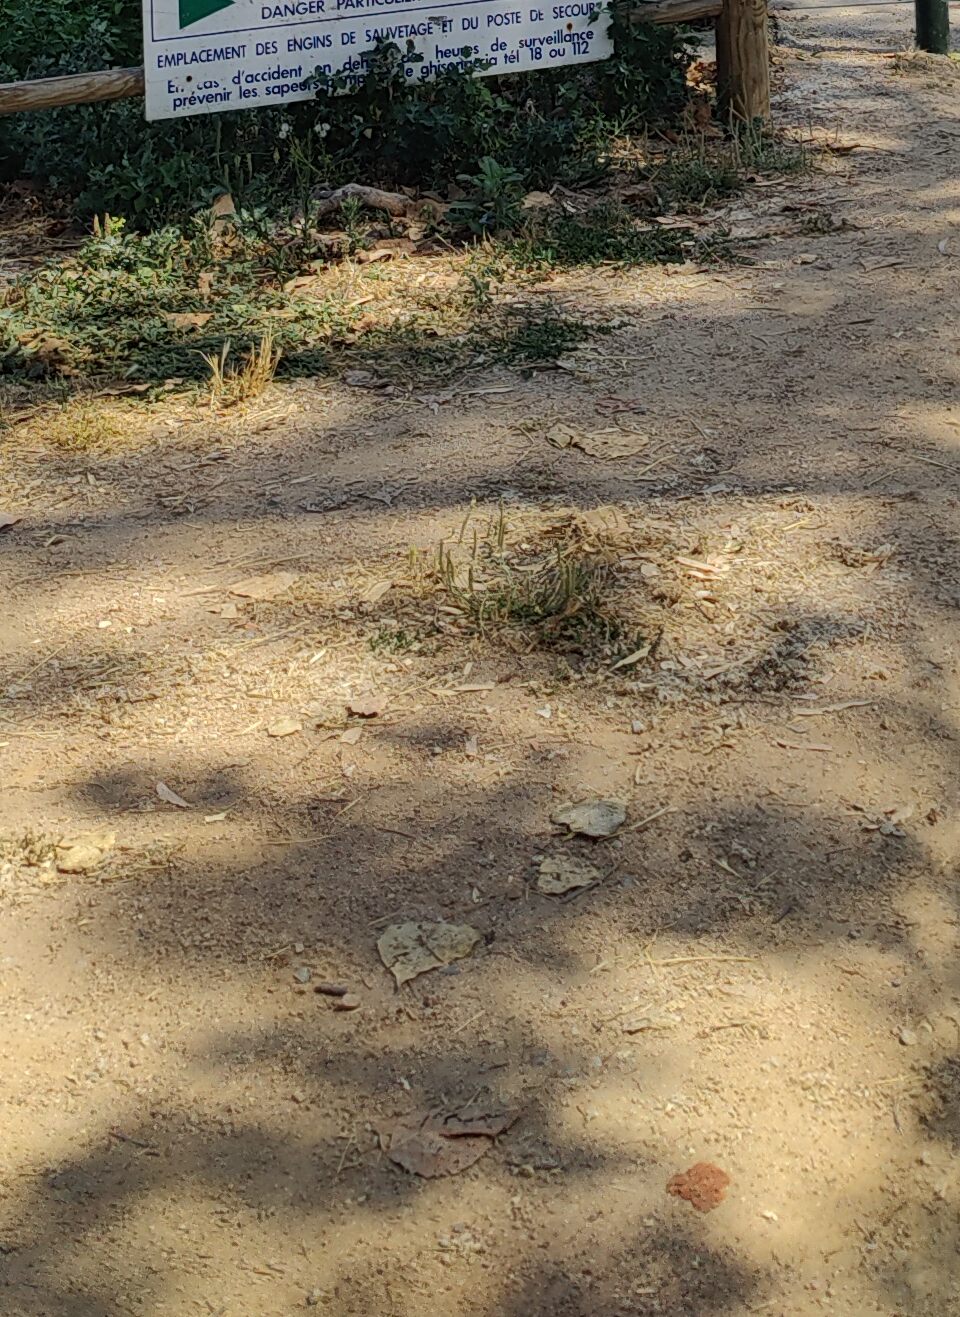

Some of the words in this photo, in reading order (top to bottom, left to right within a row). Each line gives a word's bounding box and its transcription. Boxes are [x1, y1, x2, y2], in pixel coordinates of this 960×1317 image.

[261, 0, 325, 20] DANGER
[157, 44, 247, 68] EMPLACEMENT
[255, 41, 278, 56] DES
[287, 34, 333, 53] ENGINS
[341, 31, 356, 46] DE
[365, 21, 433, 42] SAUVETAGE
[441, 19, 453, 33] ET
[462, 16, 479, 31] DU
[487, 11, 521, 27] POSTE
[530, 8, 544, 22] DE
[553, 2, 599, 19] SECOUR
[435, 44, 479, 59] heurs
[491, 37, 507, 52] de
[519, 29, 594, 49] surveillance
[504, 50, 520, 64] tél
[530, 46, 542, 61] 18
[549, 48, 566, 58] ou
[572, 41, 589, 56] 112
[168, 80, 184, 94] E
[232, 65, 302, 85] d'accident
[315, 64, 331, 75] n
[173, 88, 232, 111] prévenir
[239, 86, 258, 100] les
